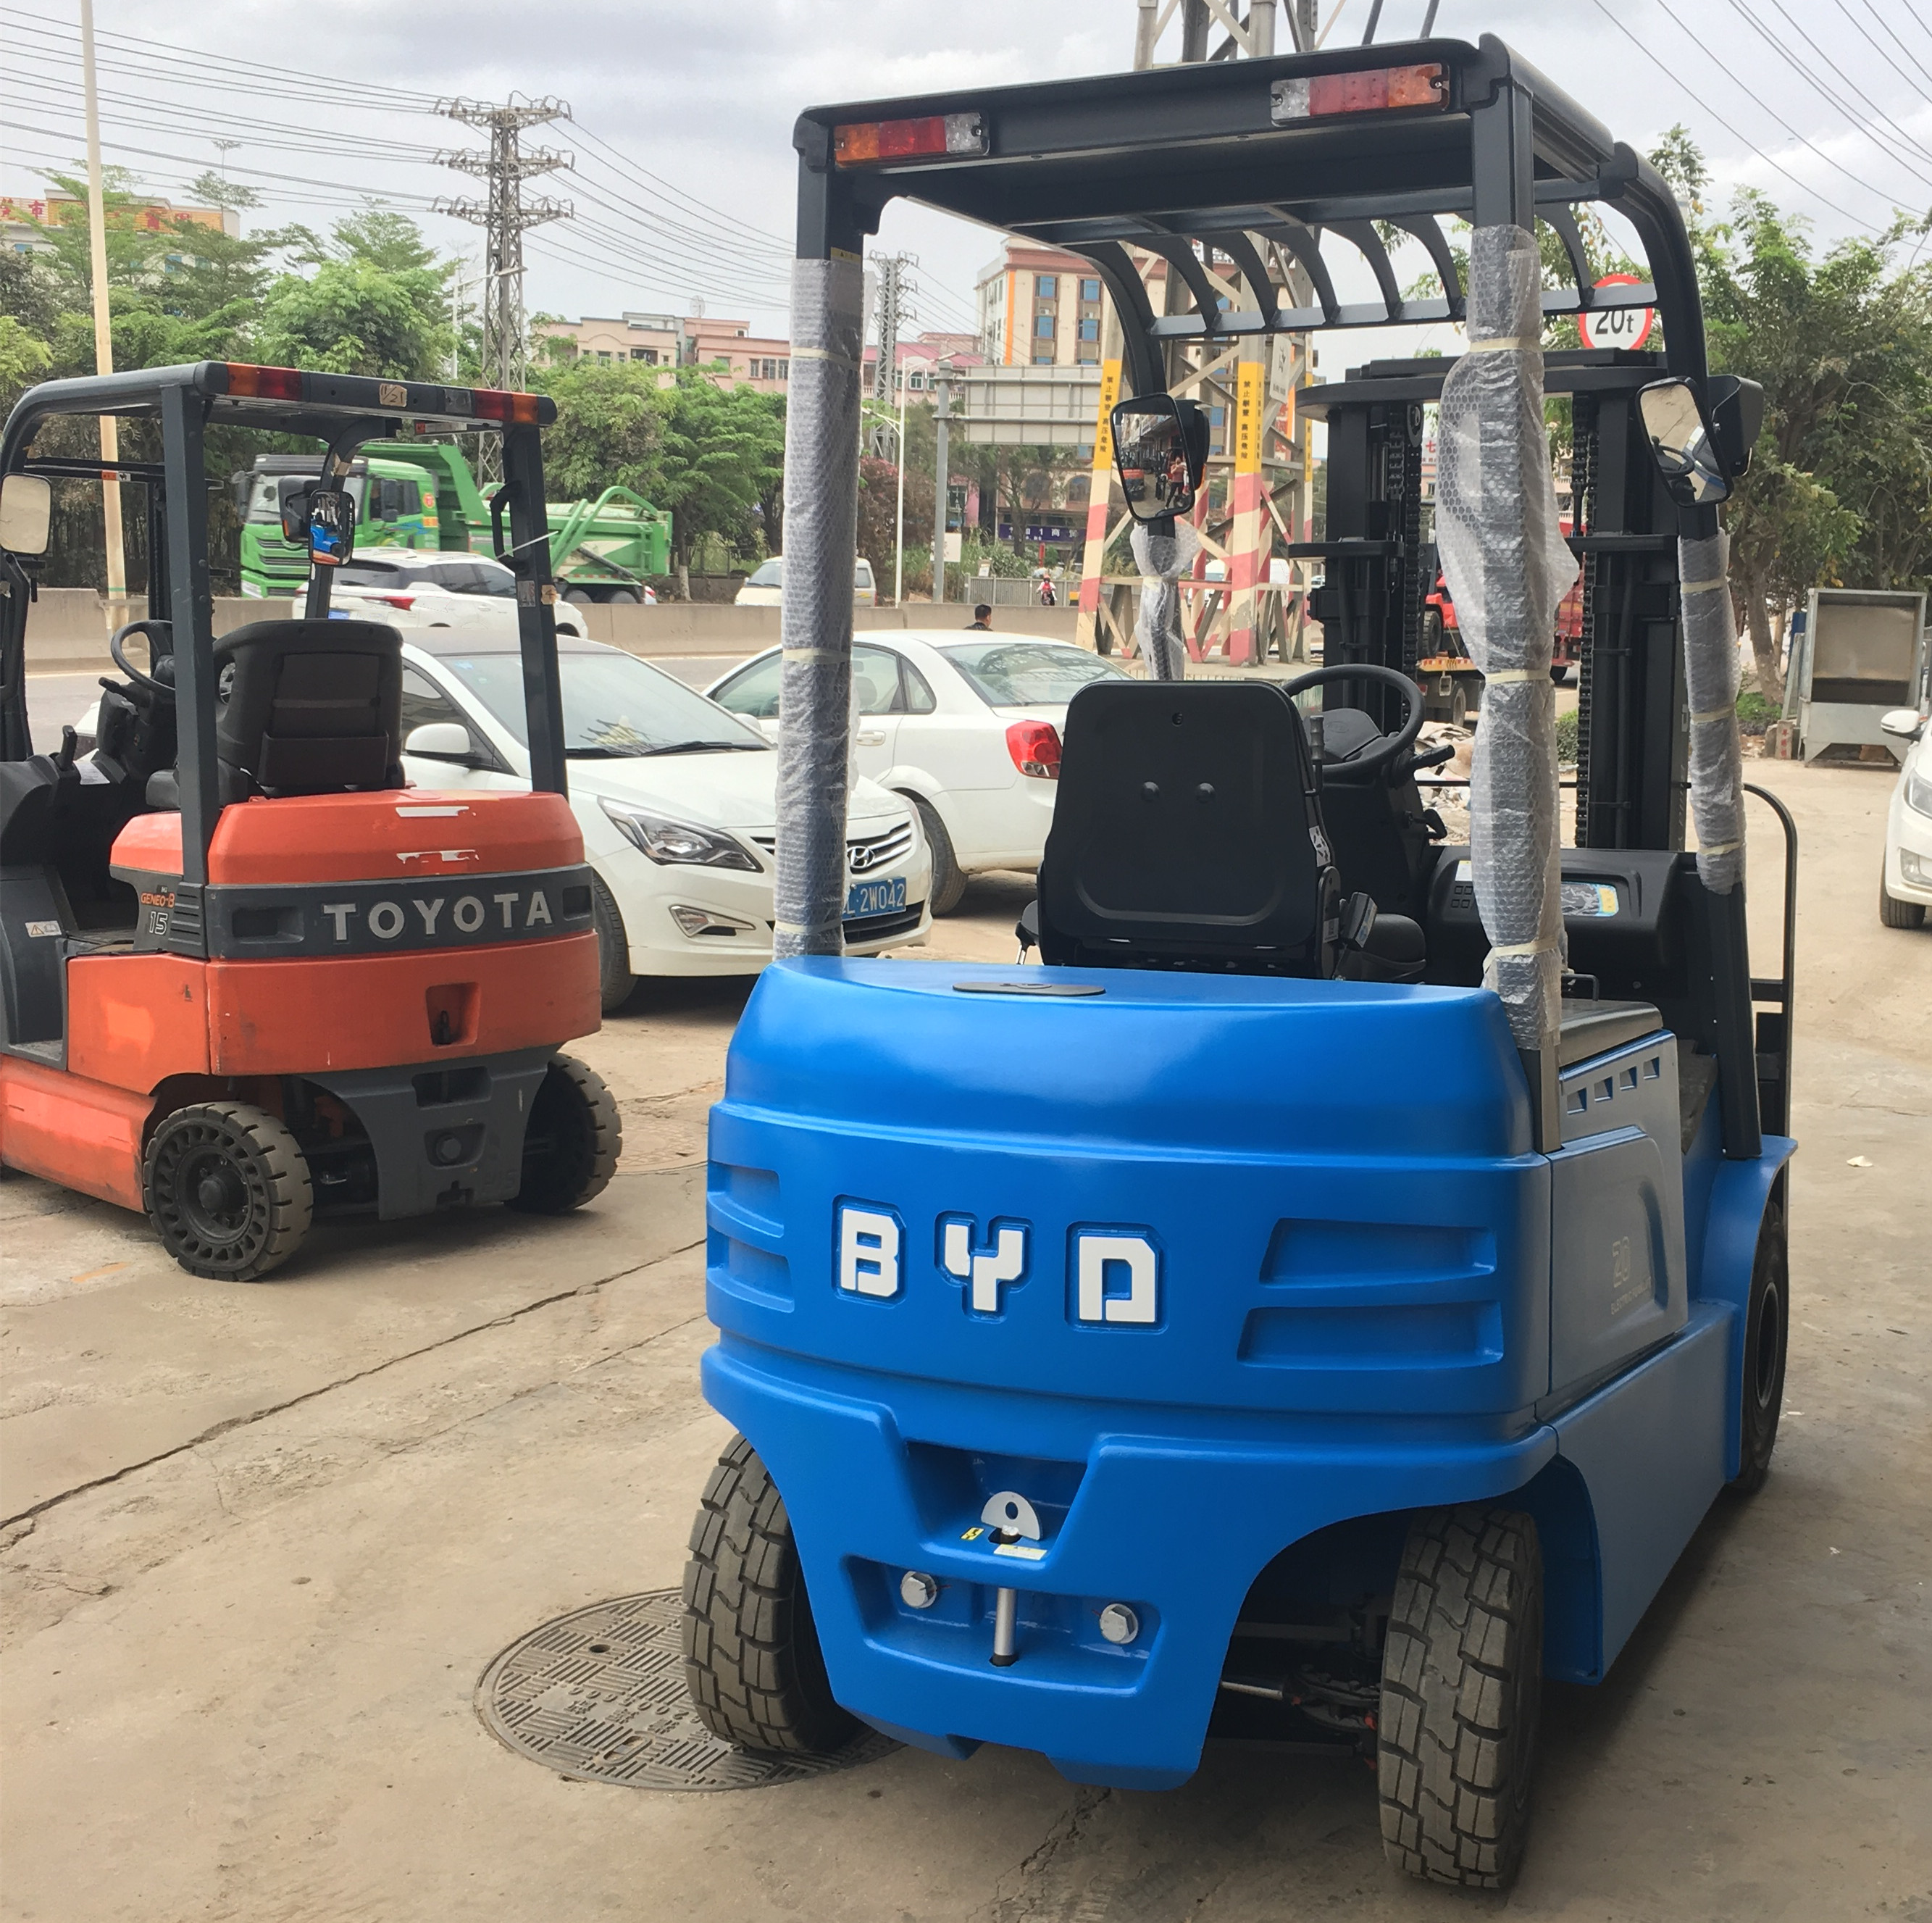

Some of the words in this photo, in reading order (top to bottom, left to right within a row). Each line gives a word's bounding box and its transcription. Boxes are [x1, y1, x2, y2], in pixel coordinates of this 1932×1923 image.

[1595, 310, 1634, 335] 20t
[141, 892, 175, 908] GENEO-B
[149, 911, 168, 935] 15
[323, 890, 553, 940] TOYOTA
[840, 1208, 1155, 1323] BYD
